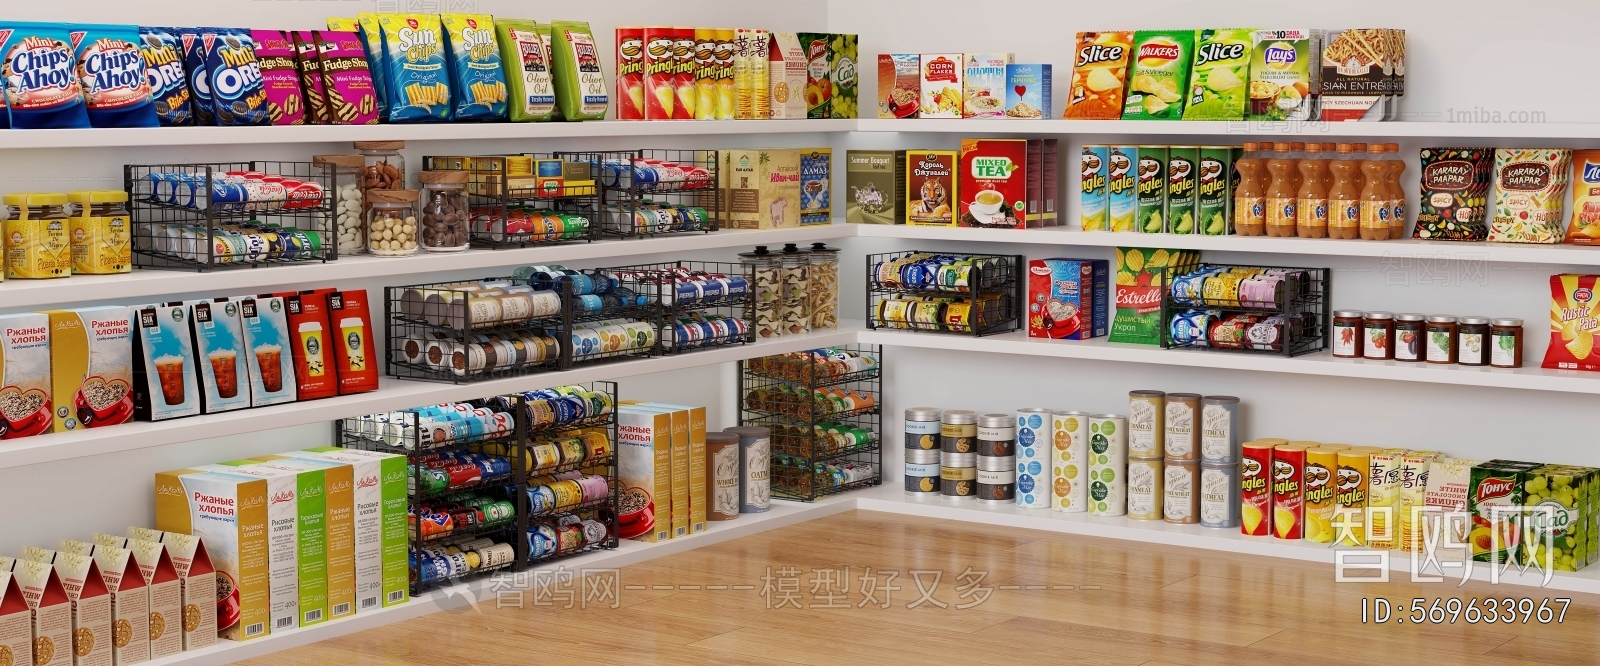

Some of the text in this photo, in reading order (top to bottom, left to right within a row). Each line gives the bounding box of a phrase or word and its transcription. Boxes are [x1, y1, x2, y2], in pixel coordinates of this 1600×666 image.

[24, 36, 57, 51] Mini
[96, 37, 126, 51] Mini
[398, 26, 437, 52] Sun
[461, 27, 493, 52] Sun
[406, 43, 437, 62] Chips
[470, 43, 495, 62] Chips
[1077, 44, 1123, 67] Slice
[1138, 47, 1179, 60] WALKERS
[1197, 43, 1244, 66] Slice
[12, 49, 69, 75] Chips
[85, 50, 141, 75] Chips
[323, 59, 352, 72] Fudge
[18, 56, 76, 94] Ahoy!
[91, 56, 146, 94] Ahoy!
[526, 73, 550, 84] Olive
[581, 74, 604, 84] Olive
[534, 84, 549, 94] Oil
[588, 84, 603, 95] Oil
[870, 156, 890, 164] Bouquet
[803, 167, 827, 175] АЛМАЗ
[976, 166, 1006, 176] TEA
[1432, 165, 1470, 177] KARARAY
[1507, 165, 1546, 177] KARARAY
[1433, 174, 1465, 184] PAAPAR
[1508, 174, 1541, 184] PAAPAR
[1433, 197, 1452, 205] SPICY
[1508, 198, 1529, 206] SPICY
[679, 291, 695, 299] PEPSI
[704, 289, 720, 297] PEPSI
[1560, 305, 1591, 322] Rustic
[91, 319, 129, 329] Ржаные
[1114, 324, 1136, 333] Укроп
[1578, 316, 1598, 331] Pata
[7, 327, 46, 337] Ржаные
[95, 327, 129, 336] хлопья
[11, 335, 46, 345] хлопья
[617, 422, 651, 434] жаные
[1481, 481, 1513, 500] Тонус
[194, 491, 234, 507] Ржаные
[198, 503, 234, 516] хлопья
